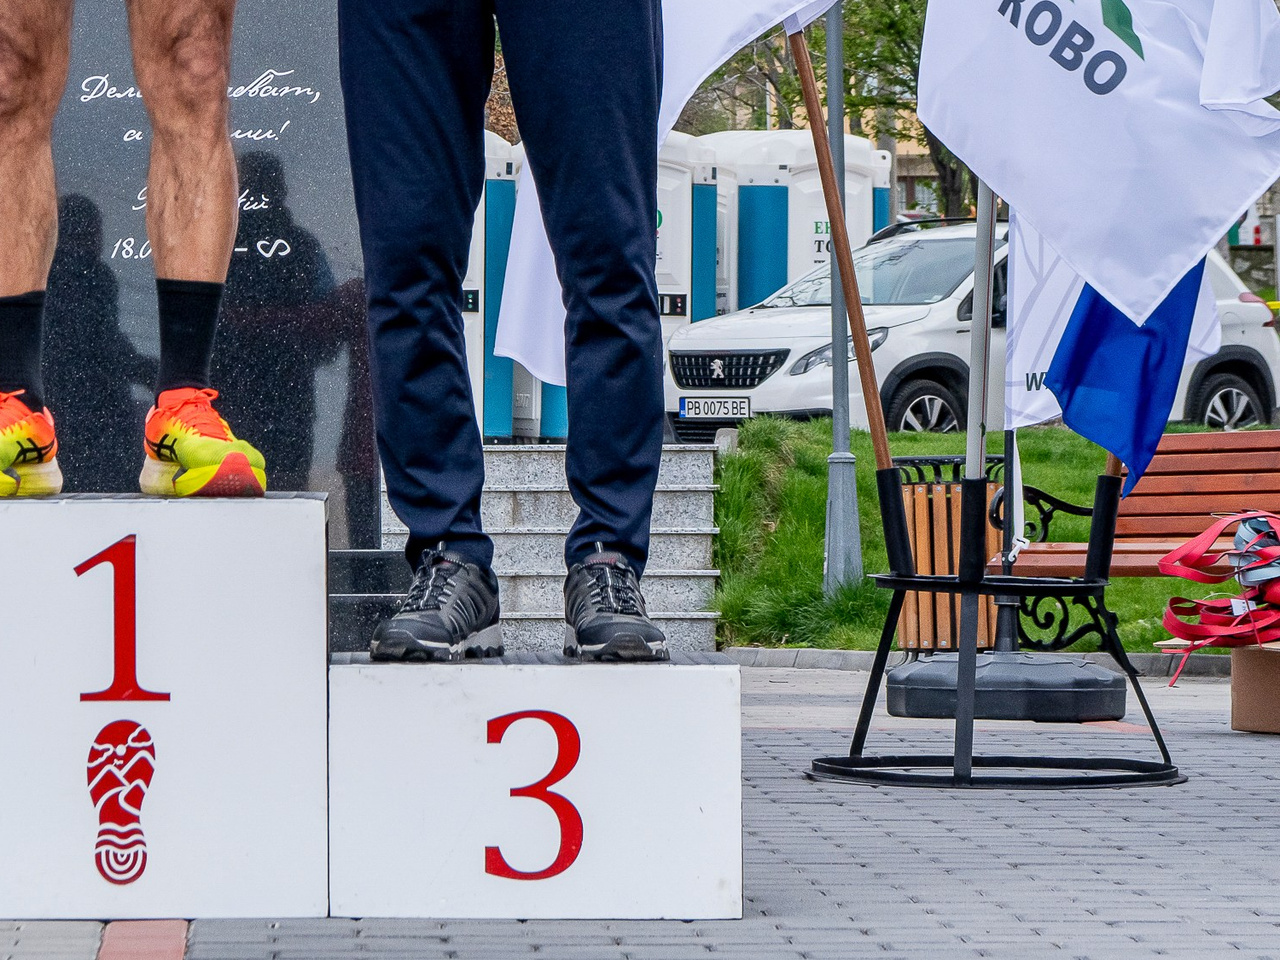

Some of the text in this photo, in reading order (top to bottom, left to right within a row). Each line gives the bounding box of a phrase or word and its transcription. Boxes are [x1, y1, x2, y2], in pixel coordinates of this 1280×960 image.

[687, 401, 746, 415] PB 0075 BE
[73, 533, 172, 702] 1
[483, 709, 583, 882] 3
